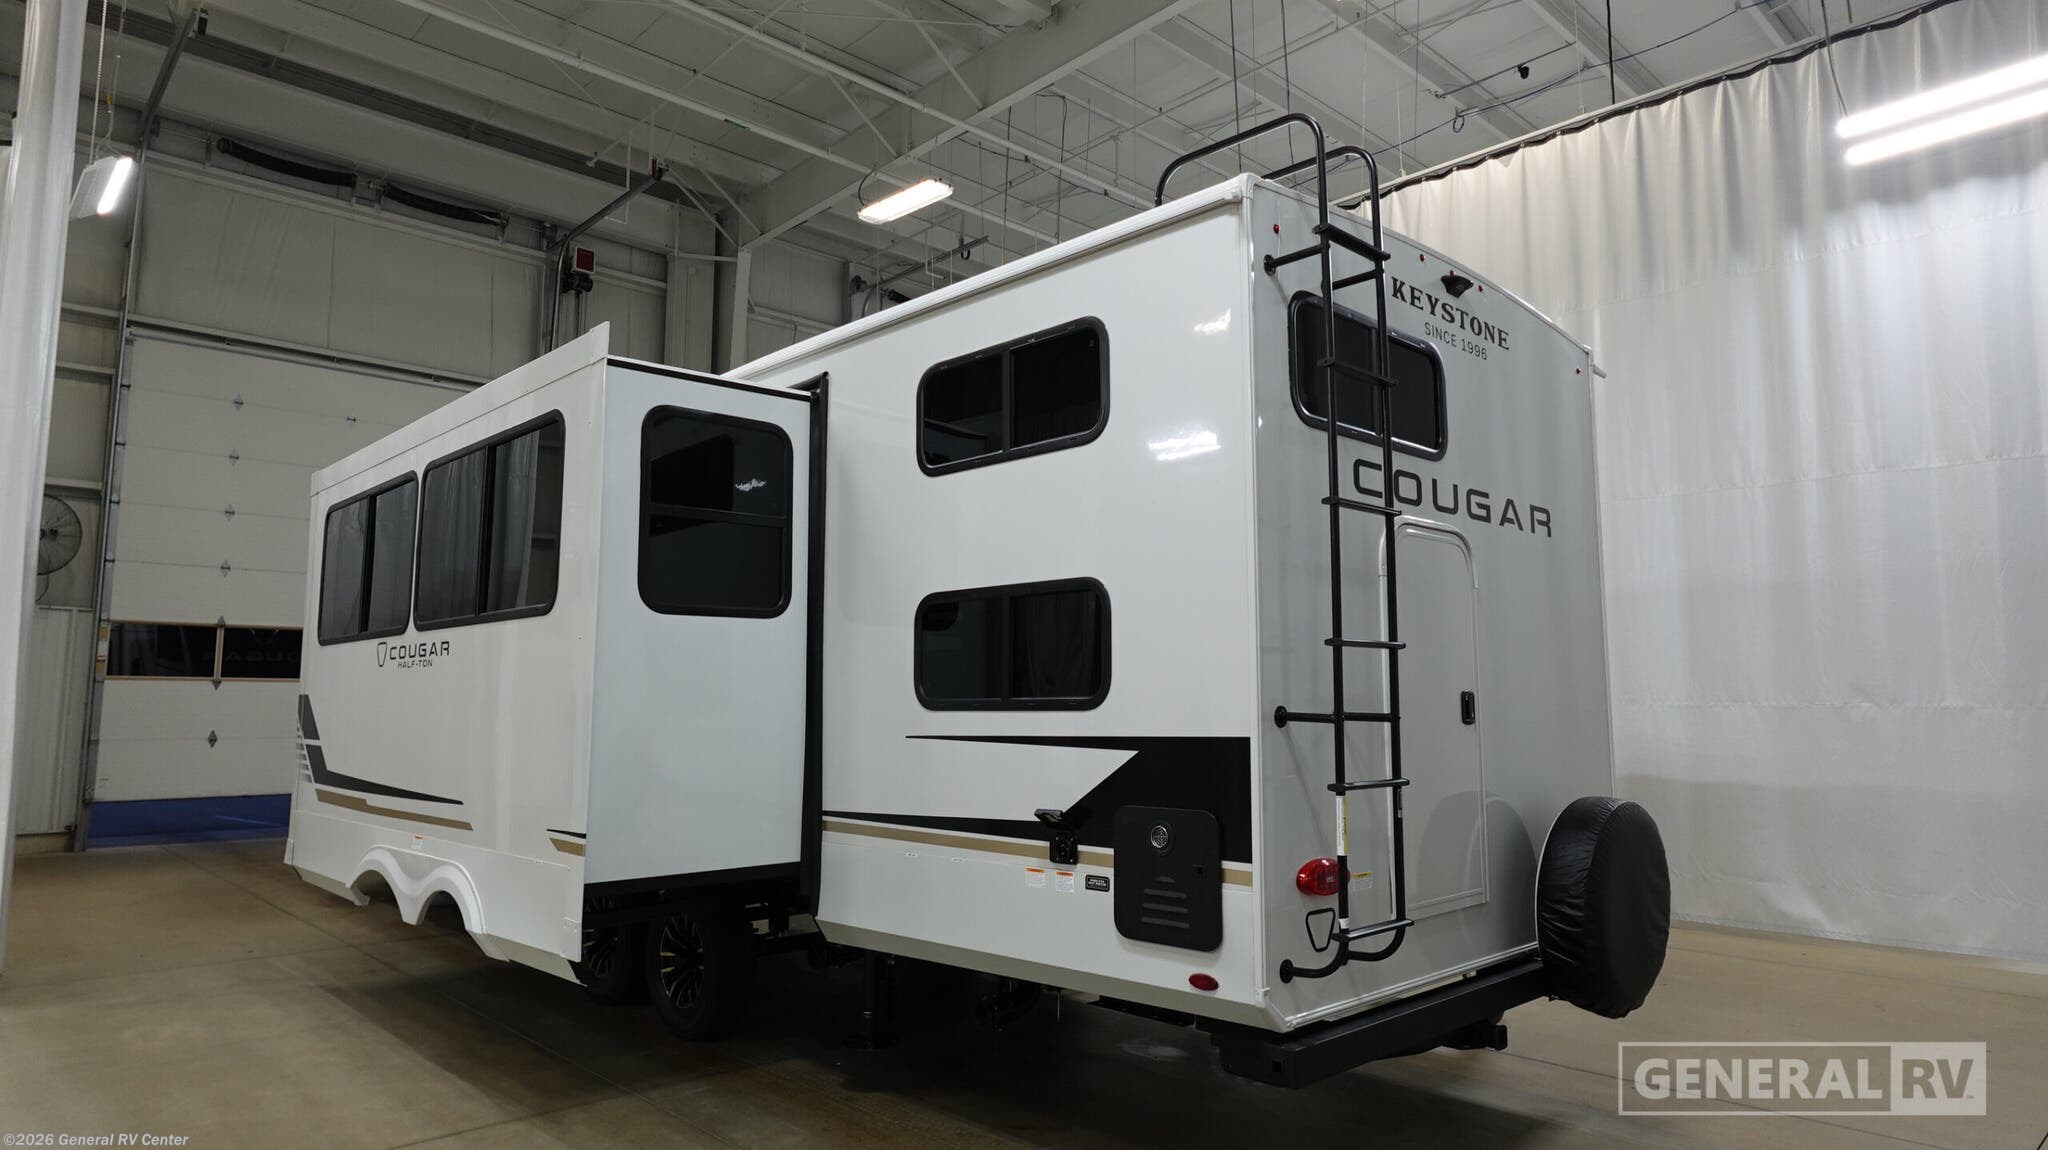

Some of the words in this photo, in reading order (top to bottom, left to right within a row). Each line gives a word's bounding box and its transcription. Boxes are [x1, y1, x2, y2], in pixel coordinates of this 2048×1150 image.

[1391, 276, 1510, 351] KEYSTONE
[1424, 322, 1457, 348] SINCE
[1461, 338, 1488, 361] 1996
[1353, 458, 1552, 538] COUGAR
[389, 641, 450, 660] COUGAR
[397, 659, 433, 669] HALF-TON
